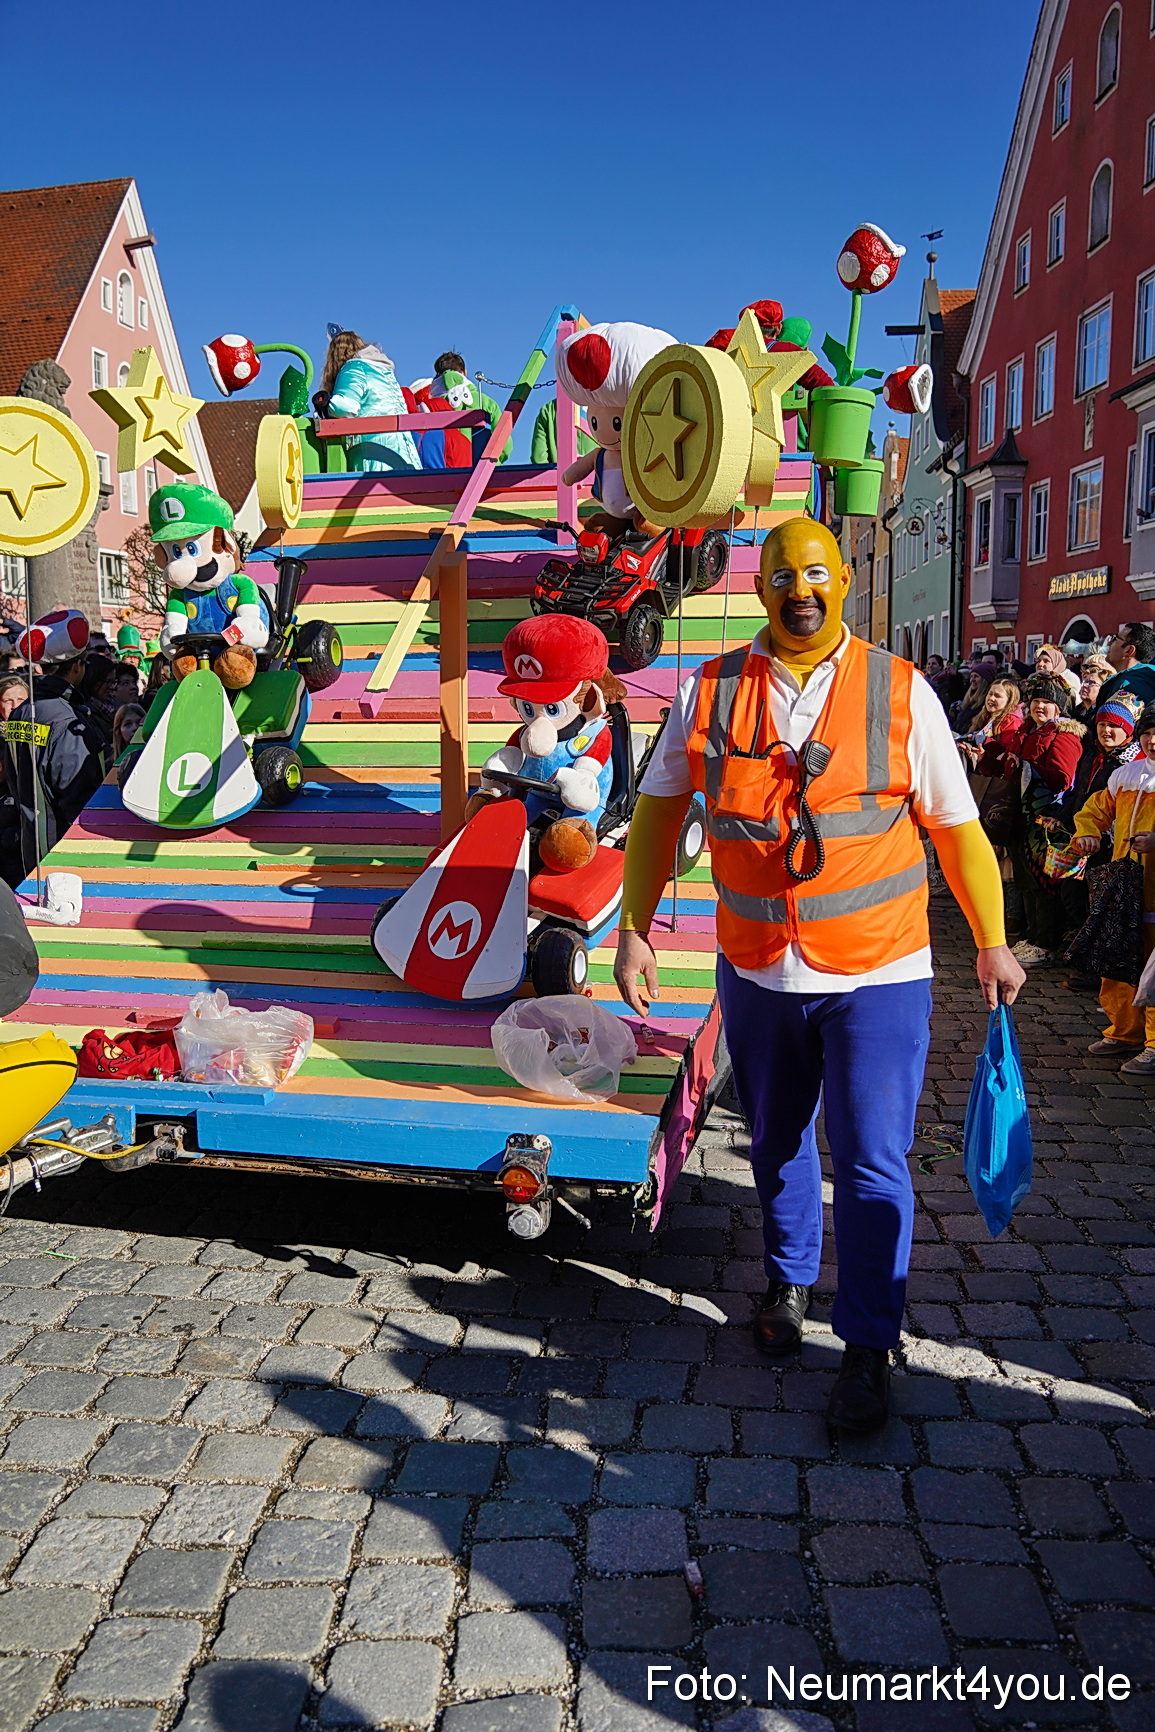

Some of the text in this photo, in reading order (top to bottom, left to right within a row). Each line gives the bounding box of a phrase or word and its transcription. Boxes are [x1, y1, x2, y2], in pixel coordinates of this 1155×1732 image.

[165, 501, 179, 519] L
[518, 658, 541, 676] M
[178, 759, 202, 792] L
[430, 910, 474, 956] M
